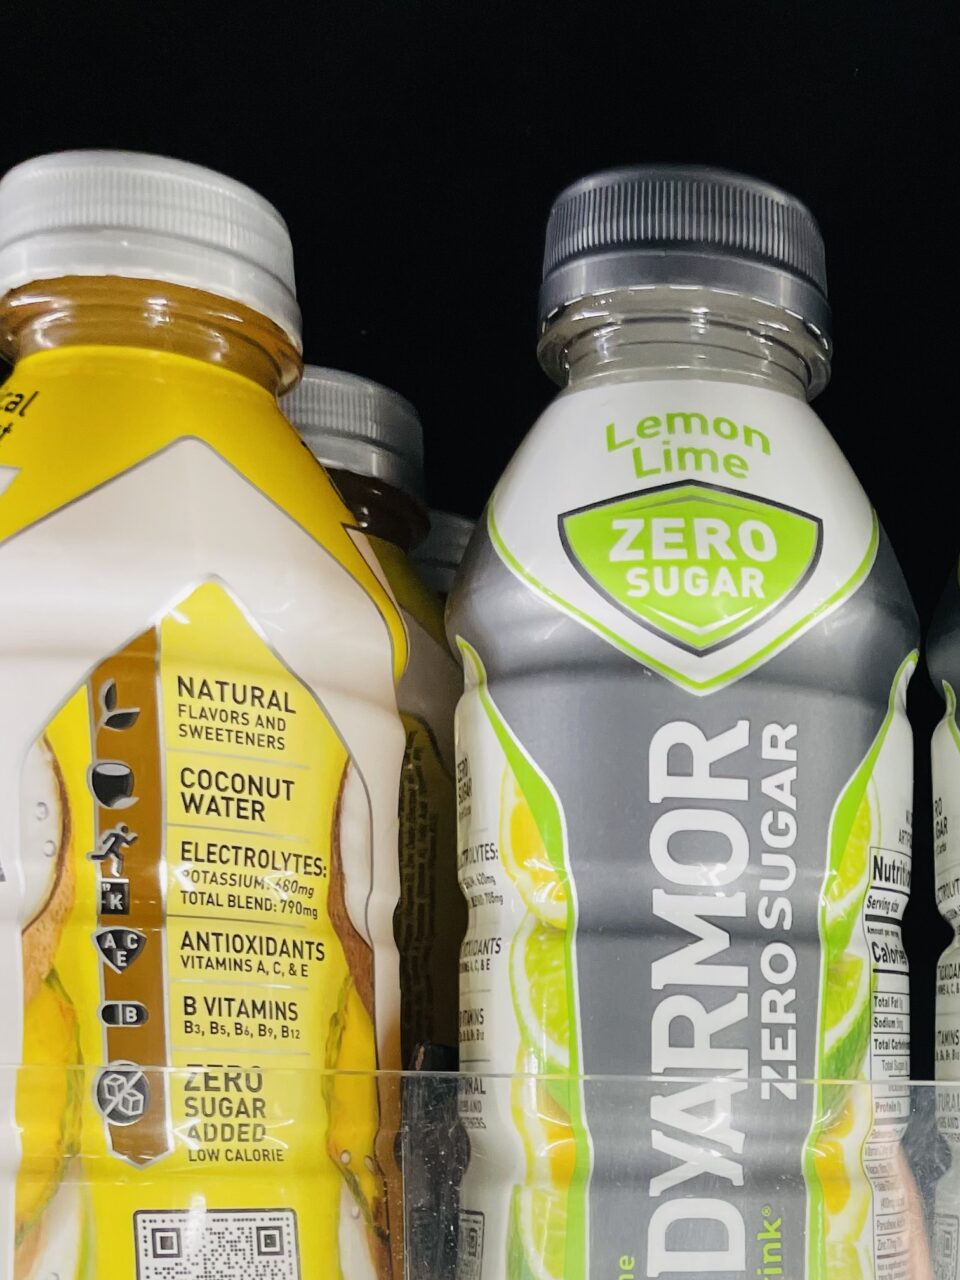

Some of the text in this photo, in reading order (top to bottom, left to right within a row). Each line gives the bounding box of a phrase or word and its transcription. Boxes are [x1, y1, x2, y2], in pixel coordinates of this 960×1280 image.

[606, 412, 771, 456] Lemon
[632, 441, 748, 479] Lime
[609, 518, 777, 562] ZERO
[626, 566, 765, 598] SUGAR
[177, 676, 296, 713] NATURAL
[178, 704, 286, 731] FLAVORS AND
[179, 724, 285, 750] SWEETENERS
[180, 767, 295, 800] COCONUT
[180, 792, 265, 822] WATER
[181, 841, 327, 878] ELECTROLYTES:
[182, 869, 269, 890] POTASSIUM:
[180, 891, 318, 919] TOTAL BLEND: 790mg
[758, 722, 798, 1100] ZERO SUGAR
[104, 933, 138, 949] A C
[181, 931, 325, 961] ANTIOXIDANTS
[117, 951, 127, 967] E
[181, 956, 309, 977] VITAMINS A, C, & E
[126, 1008, 138, 1022] B
[184, 996, 298, 1021] B VITAMINS
[874, 996, 890, 1008] Total
[184, 1064, 263, 1093] ZERO
[184, 1097, 266, 1118] SUGAR
[188, 1124, 267, 1142] ADDED
[188, 1149, 284, 1162] LOW CALORIE
